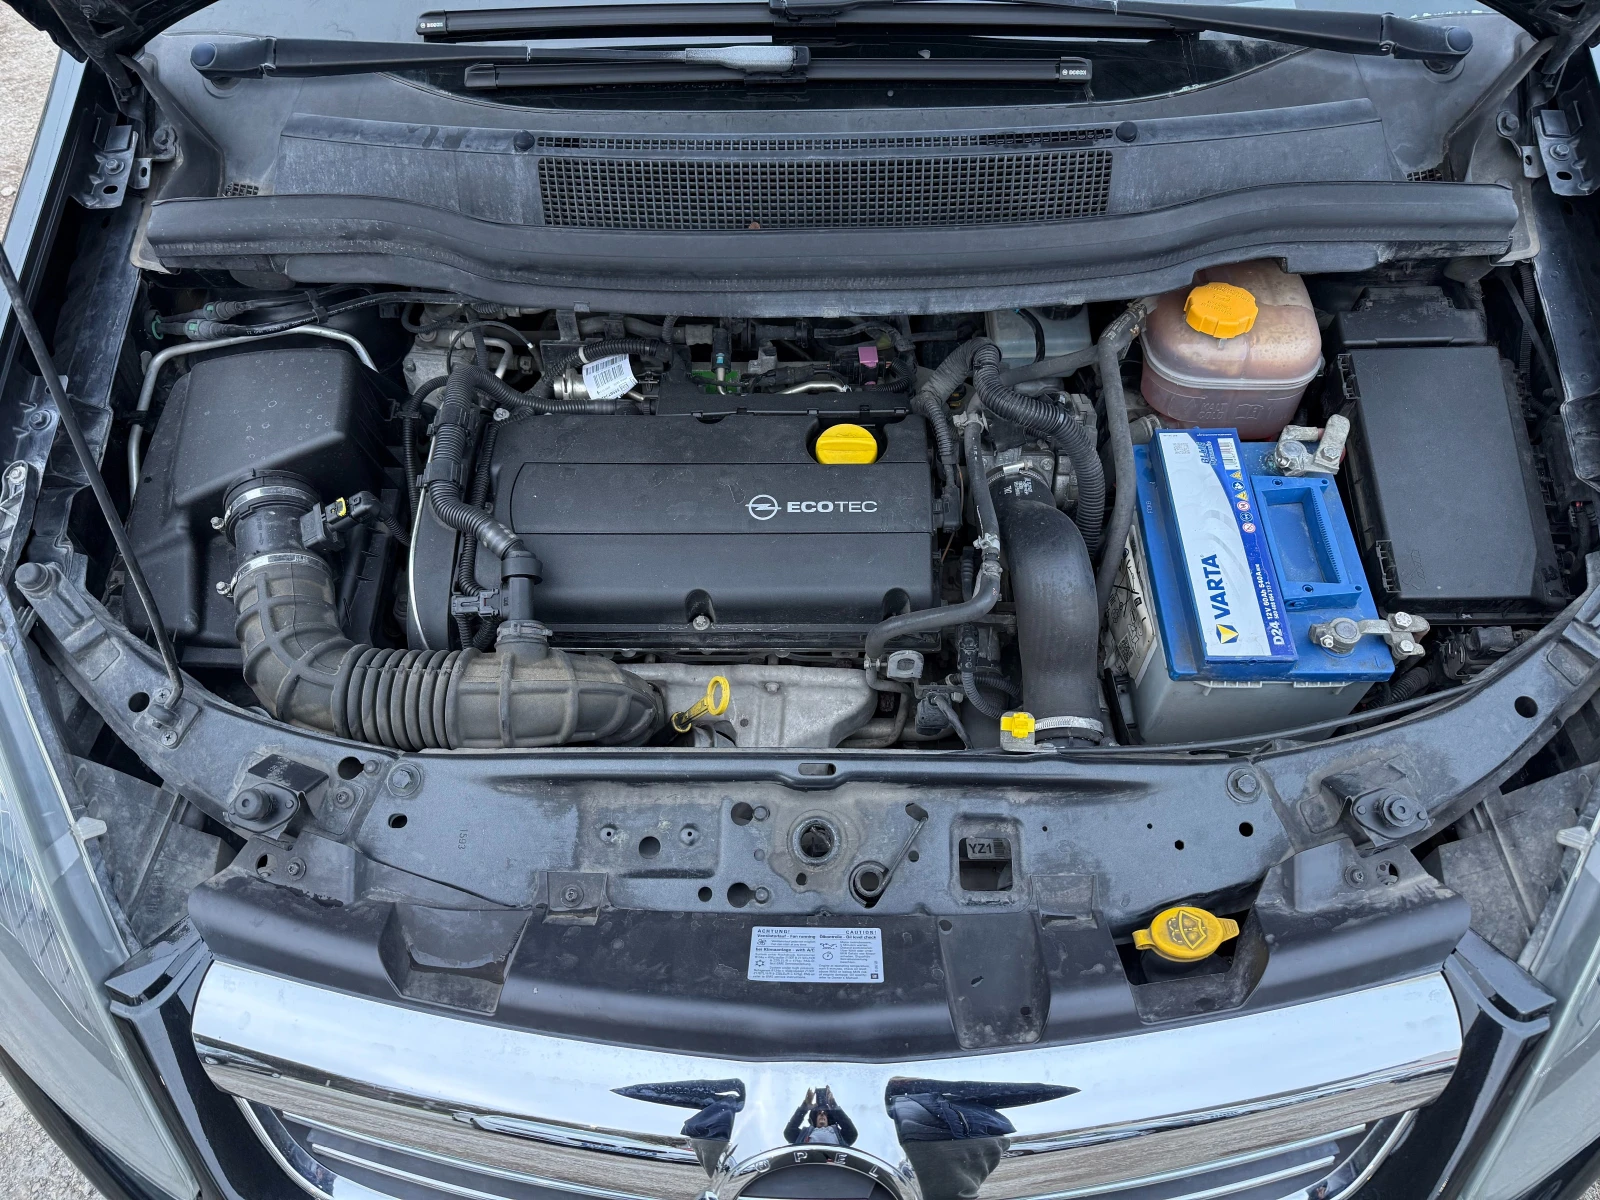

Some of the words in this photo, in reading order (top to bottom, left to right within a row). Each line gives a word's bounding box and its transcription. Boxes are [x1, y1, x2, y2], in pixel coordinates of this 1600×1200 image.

[787, 500, 878, 513] ECOTEC
[1201, 554, 1231, 620] VARTA
[1266, 607, 1274, 620] 12V
[1270, 621, 1285, 645] D24
[457, 829, 469, 850] 1593
[968, 842, 992, 855] YZ1
[754, 1151, 879, 1178] OPEL
